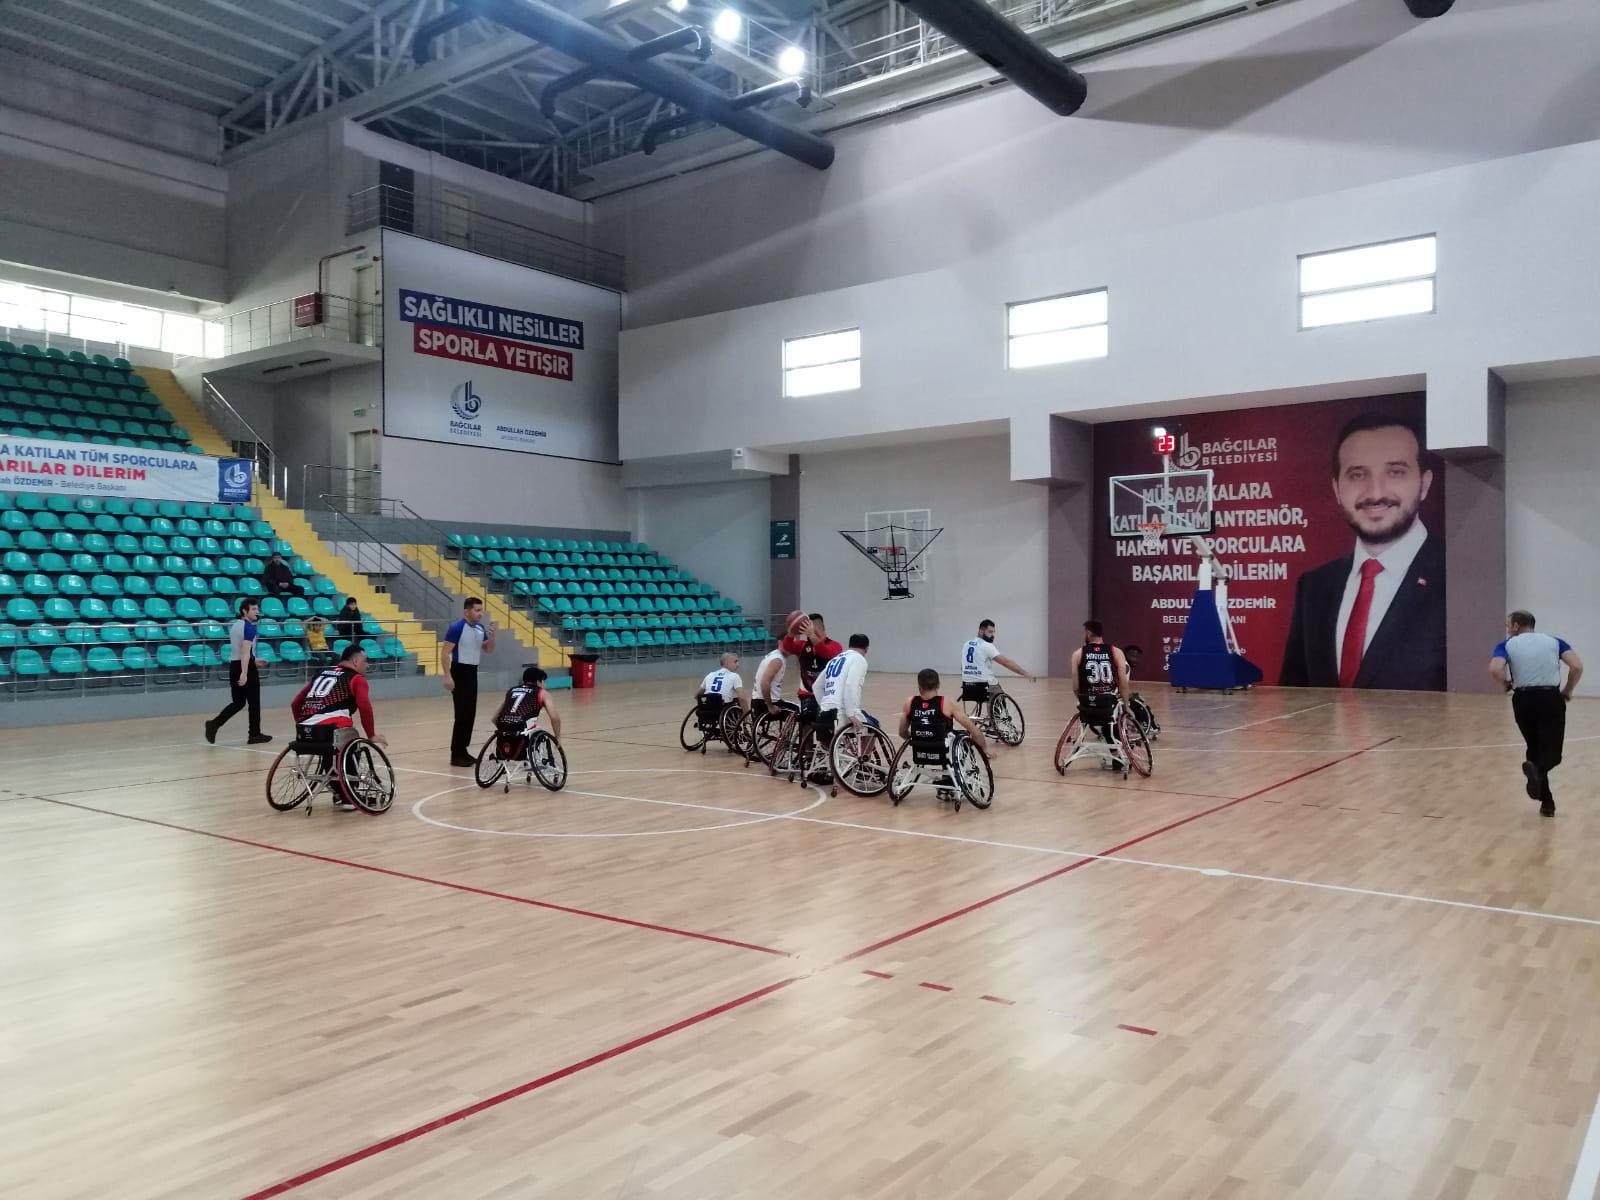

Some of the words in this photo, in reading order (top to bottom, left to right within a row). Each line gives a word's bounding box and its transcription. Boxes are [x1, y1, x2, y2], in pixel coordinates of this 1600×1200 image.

[404, 296, 494, 330] SAĞLIKLI
[418, 328, 499, 362] SPORLA
[1158, 436, 1175, 451] 23
[1202, 437, 1277, 454] BAĞCILAR
[14, 445, 76, 461] KATILAN
[80, 449, 109, 463] TÜM
[112, 453, 198, 471] SPORCULARA
[1202, 448, 1277, 466] BELEDİYESİ
[1215, 504, 1308, 528] ANTRENÖR,
[1116, 539, 1168, 556] HAKEM
[1172, 538, 1193, 555] VE
[1228, 596, 1277, 609] ZDEMİR
[966, 646, 975, 664] 8
[1085, 660, 1113, 684] 30
[306, 675, 338, 698] 10
[711, 676, 724, 692] 5
[511, 691, 527, 713] 7
